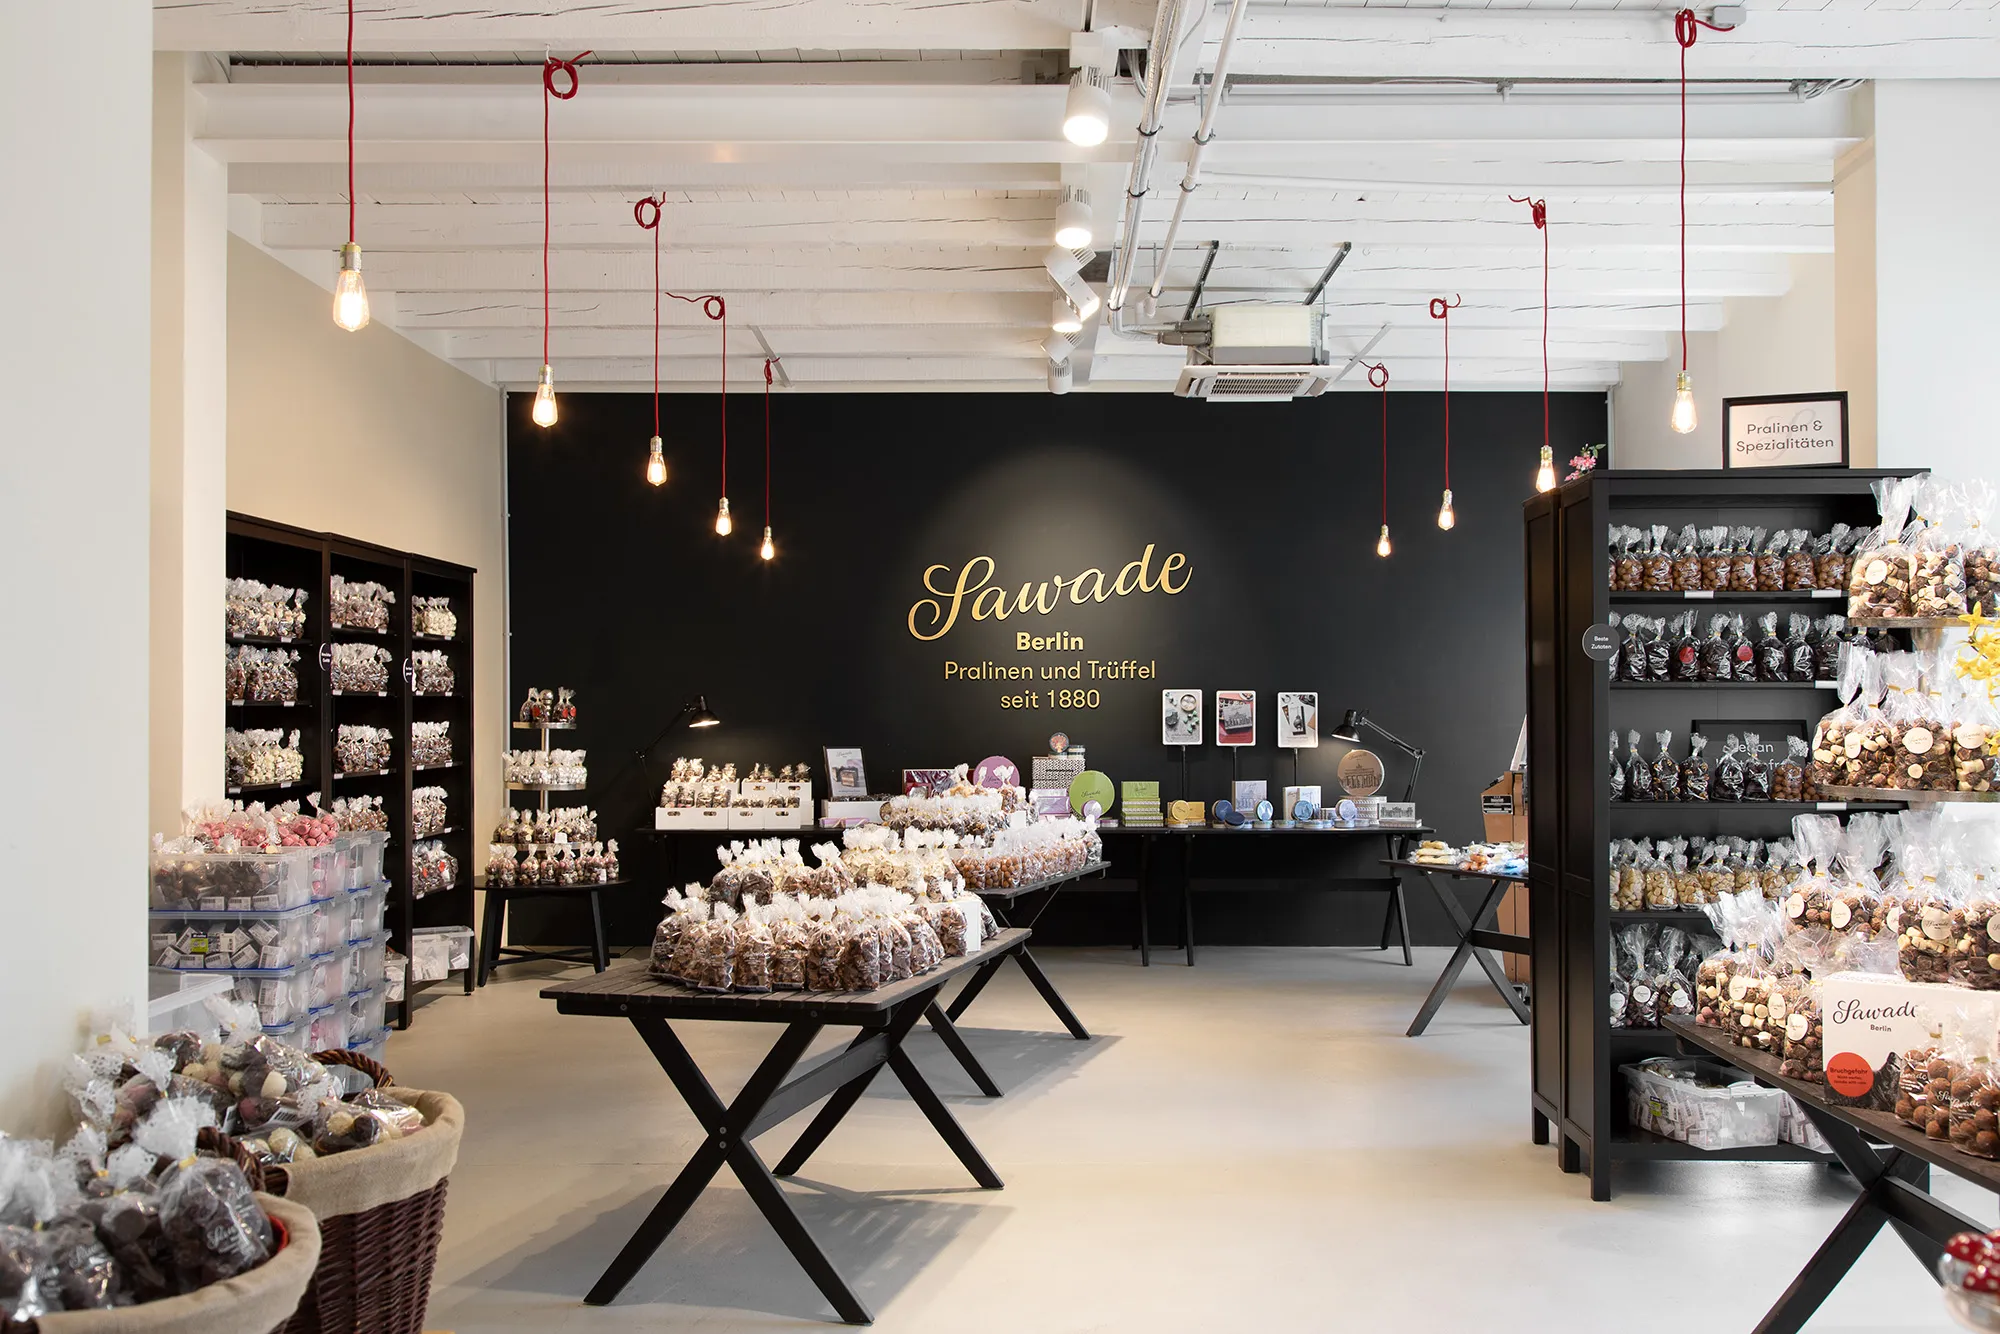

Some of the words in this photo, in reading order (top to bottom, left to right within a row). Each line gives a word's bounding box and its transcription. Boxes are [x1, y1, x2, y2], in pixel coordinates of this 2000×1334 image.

[1747, 422, 1808, 435] Pralinen
[1813, 420, 1823, 431] &
[1736, 438, 1834, 454] Spezialitäten
[908, 543, 1194, 641] Sawade
[1016, 631, 1085, 651] Berlin
[944, 660, 1034, 681] Pralinen
[1040, 661, 1082, 681] und
[1087, 660, 1157, 681] Trüffel
[1000, 690, 1040, 710] seit
[1047, 689, 1101, 710] 1880
[1870, 1024, 1892, 1033] Berlin
